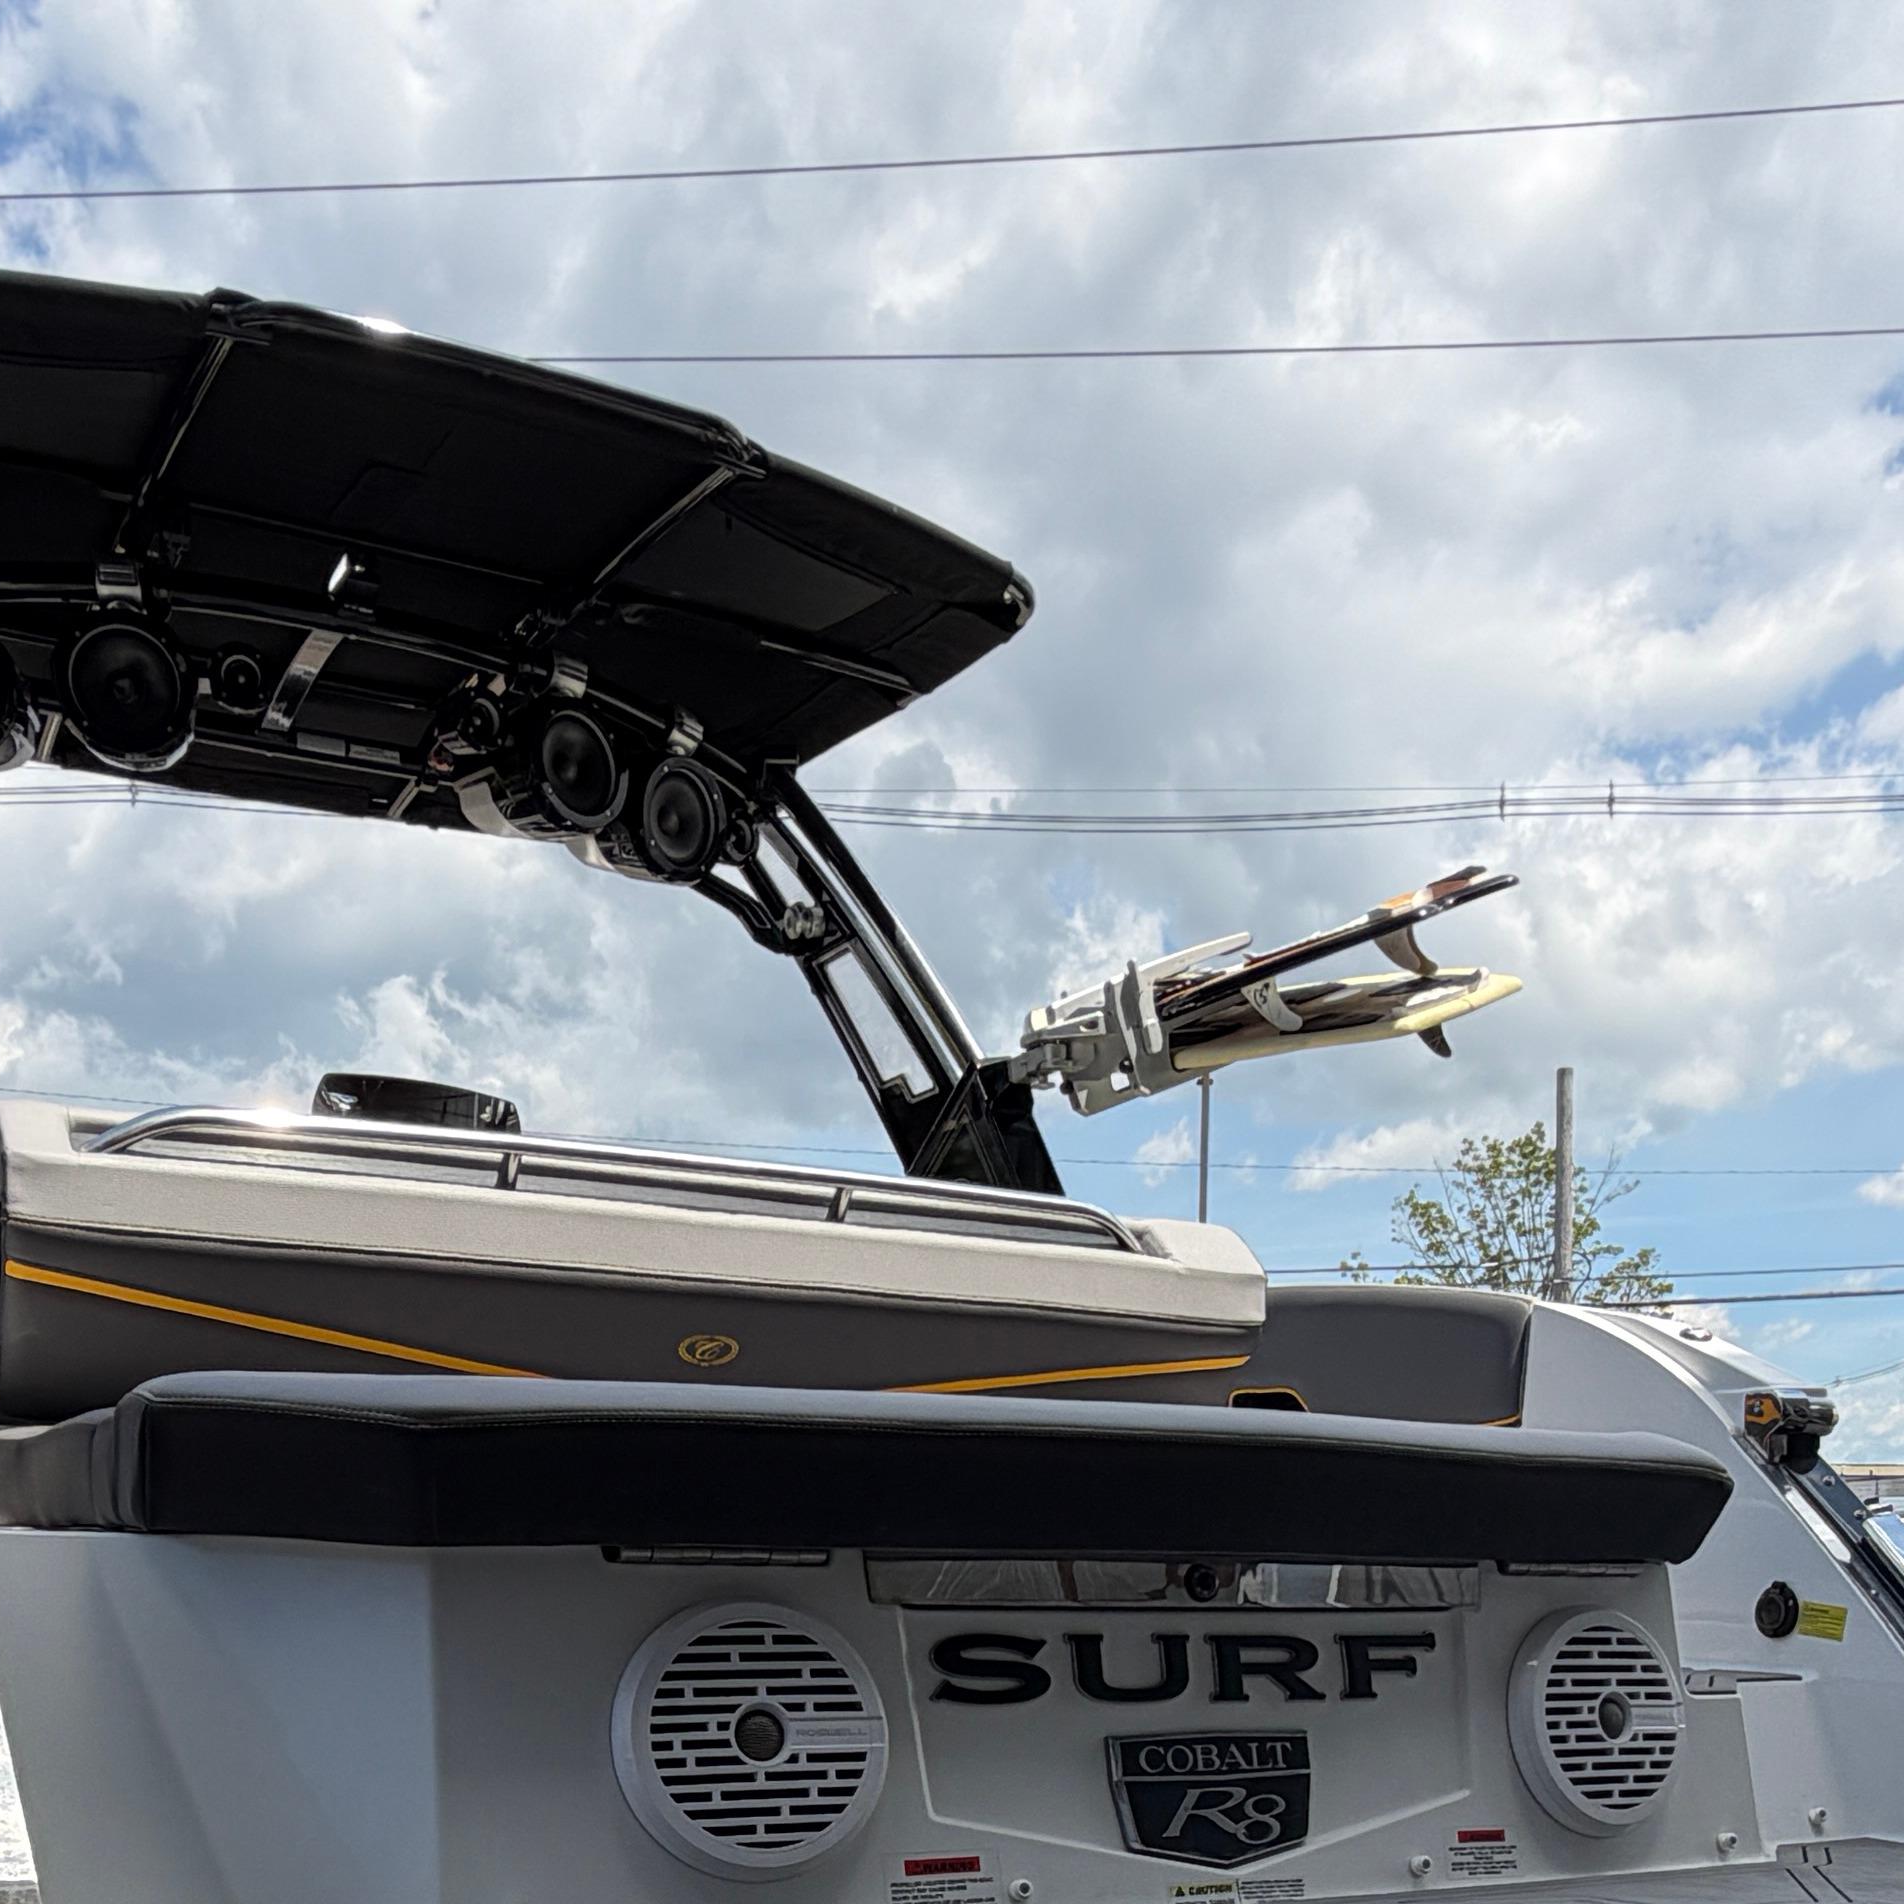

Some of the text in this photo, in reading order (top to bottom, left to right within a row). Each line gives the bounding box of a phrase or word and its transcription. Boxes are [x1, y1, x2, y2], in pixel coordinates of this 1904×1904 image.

[928, 1630, 1436, 1704] SURF
[1138, 1741, 1294, 1775] COBALT
[1161, 1785, 1287, 1846] R8
[1188, 1884, 1232, 1896] CAUTION
